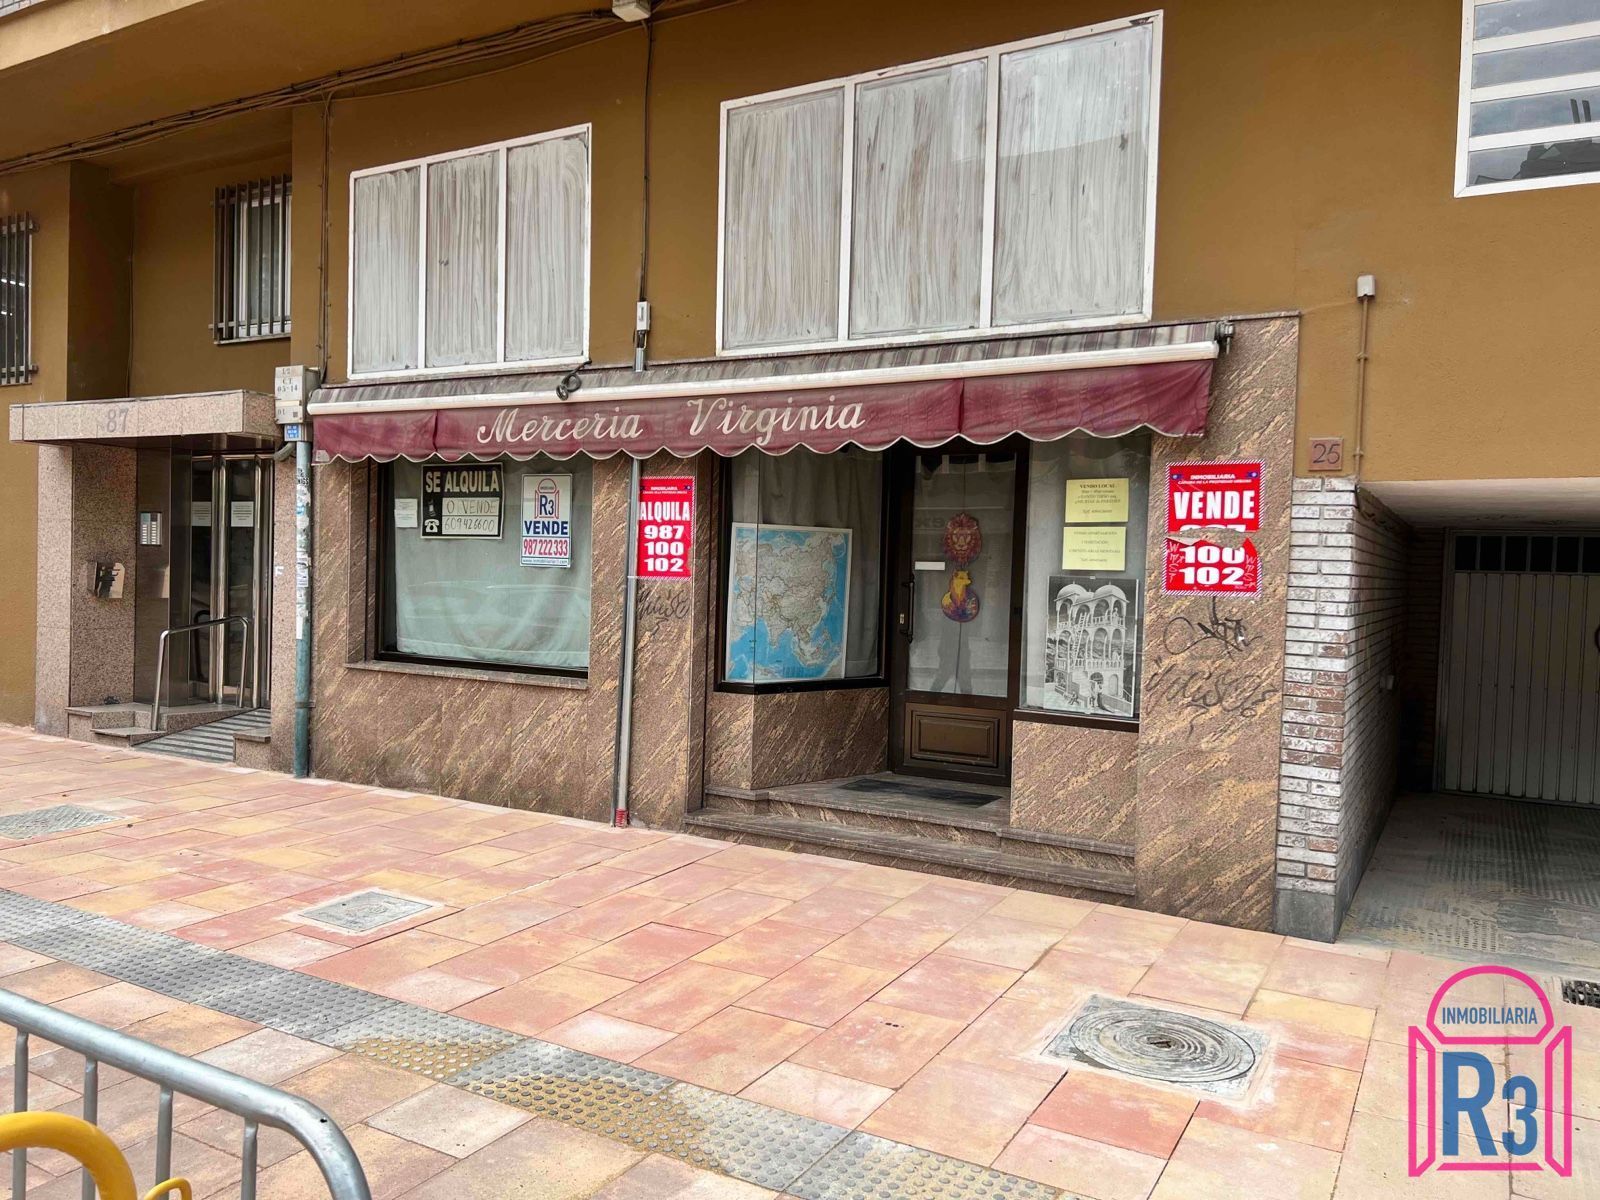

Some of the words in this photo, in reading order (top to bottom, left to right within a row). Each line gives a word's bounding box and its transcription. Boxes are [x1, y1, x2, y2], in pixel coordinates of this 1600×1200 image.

[107, 408, 129, 433] 87
[477, 407, 643, 444] Merceria
[687, 394, 866, 446] Virginia
[1312, 443, 1341, 465] 25
[425, 471, 441, 493] SE
[444, 470, 500, 493] ALQUILA
[461, 500, 498, 514] VENDE
[539, 494, 555, 516] R3
[639, 501, 691, 521] ALQUILA
[1173, 490, 1255, 520] VENDE
[524, 520, 569, 536] VENDE
[644, 525, 685, 540] 987
[644, 541, 685, 556] 100
[1179, 545, 1246, 564] 100
[644, 557, 684, 572] 102
[1178, 566, 1245, 585] 102
